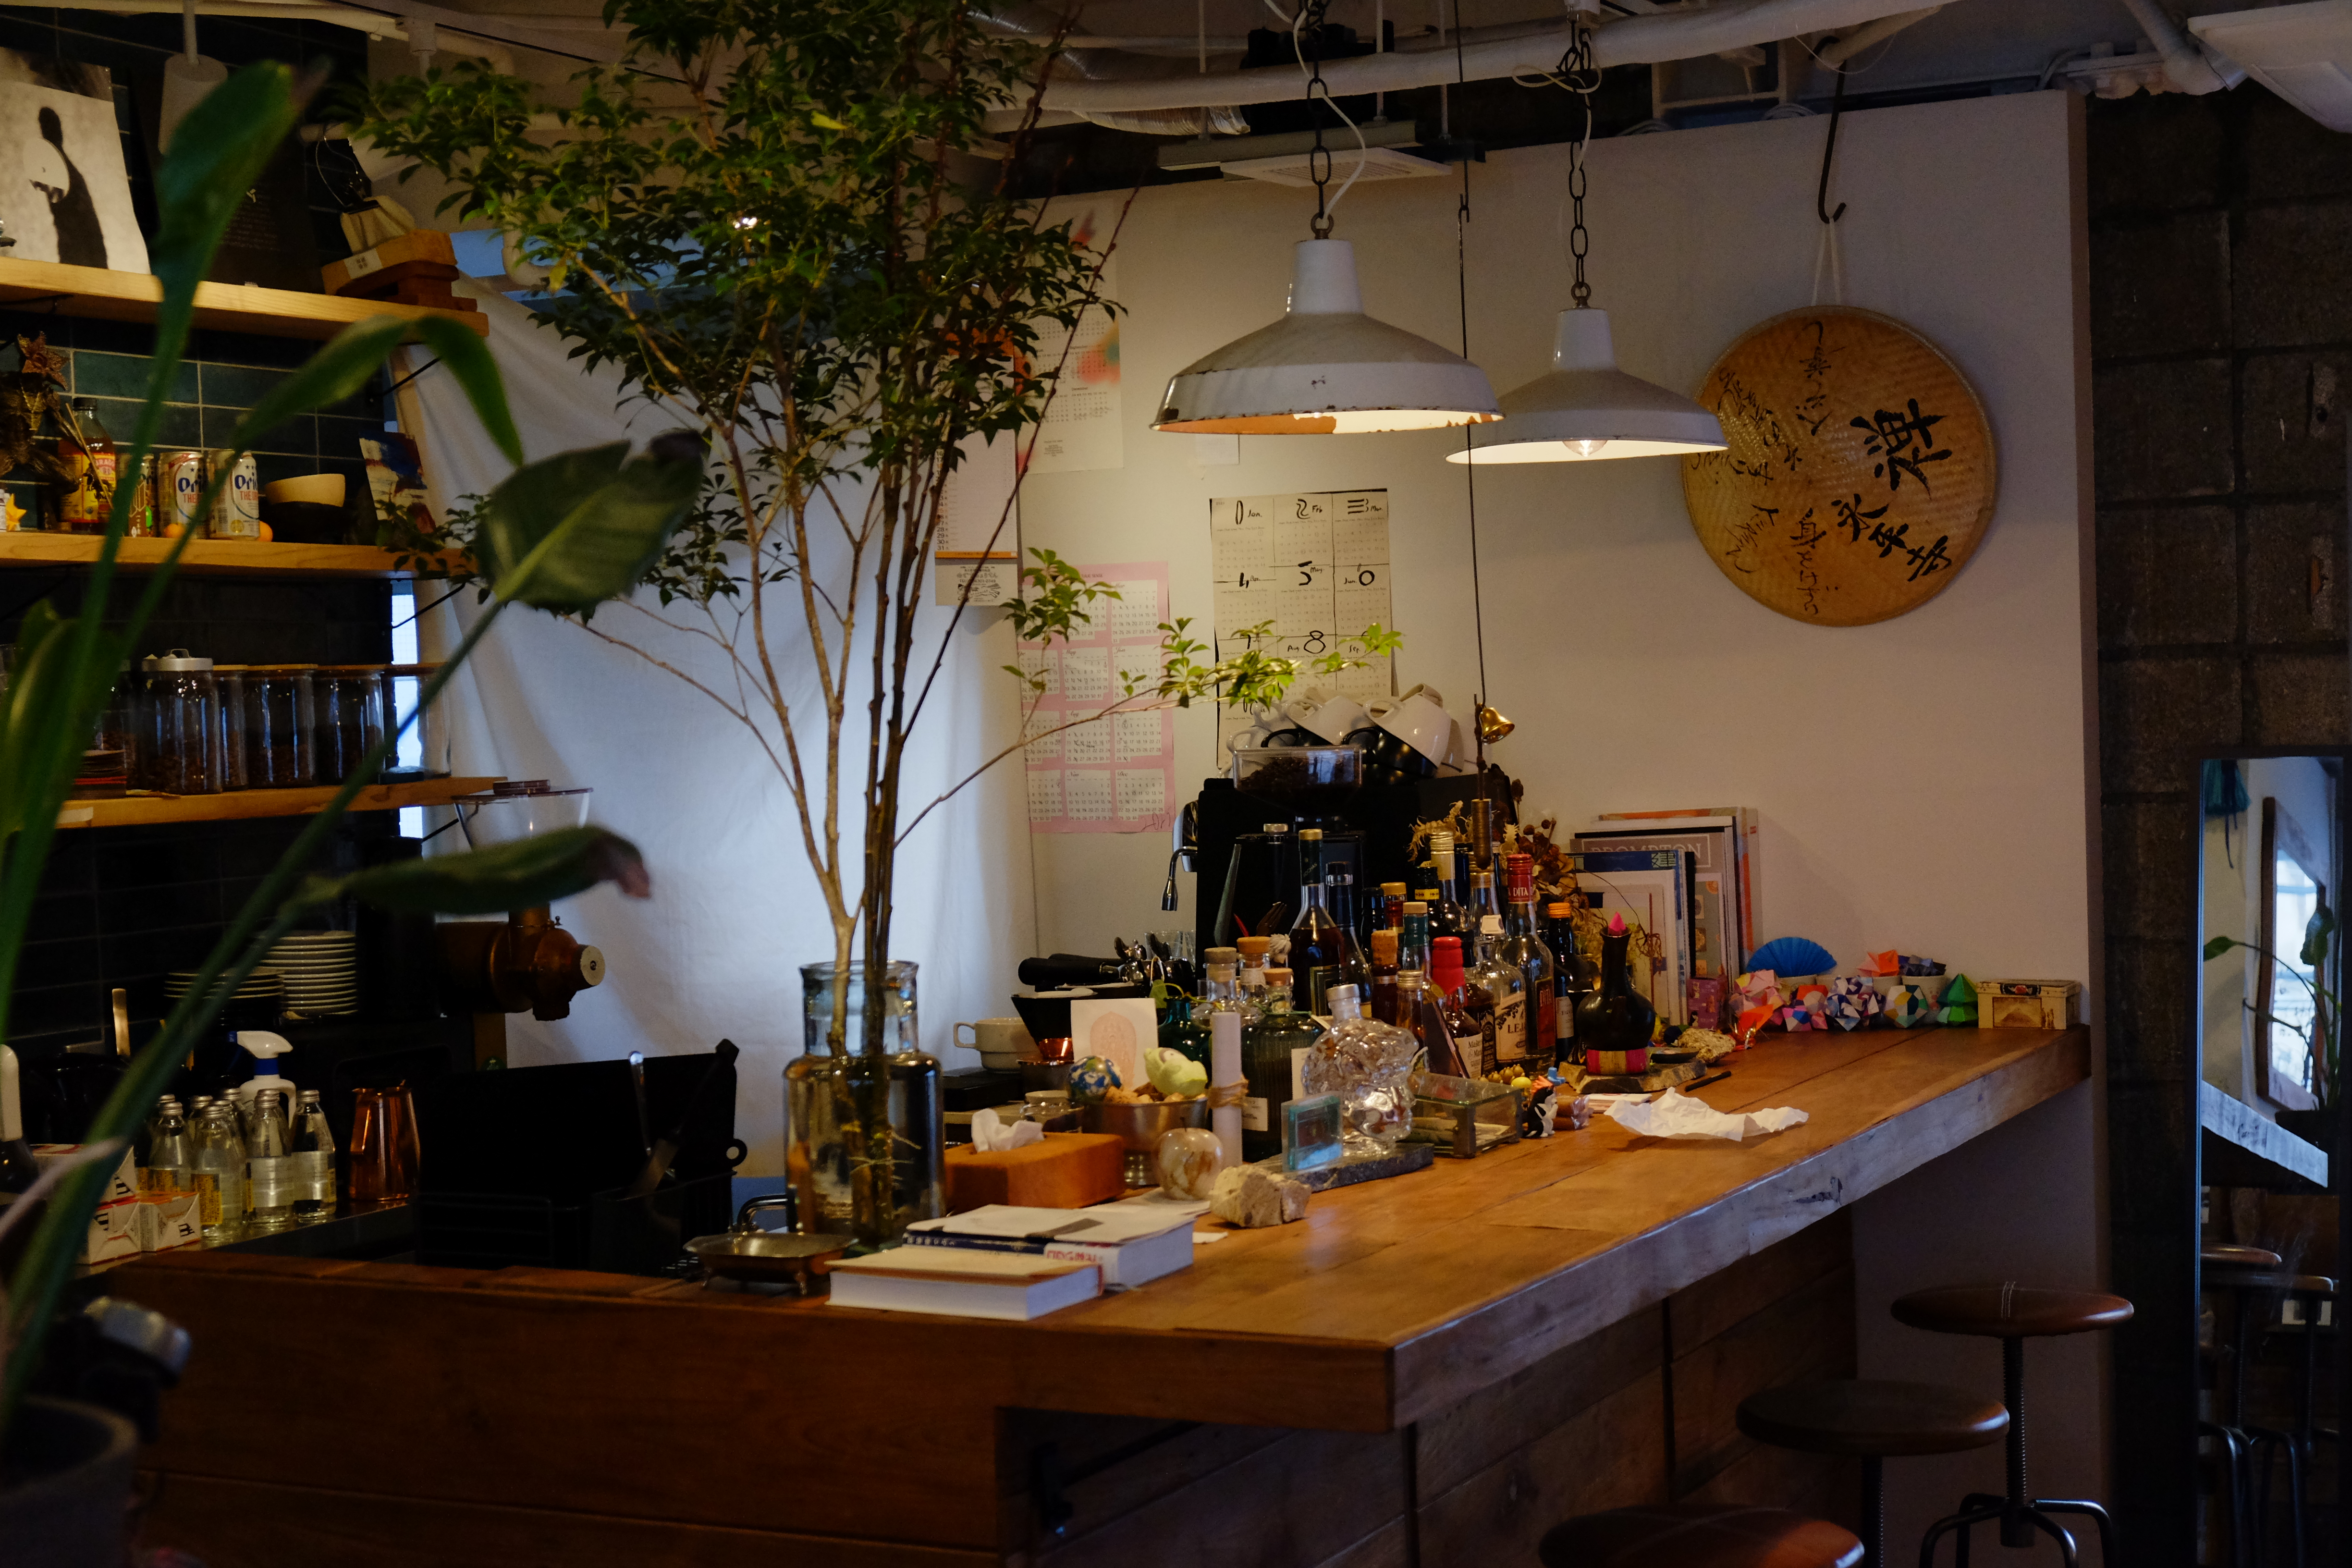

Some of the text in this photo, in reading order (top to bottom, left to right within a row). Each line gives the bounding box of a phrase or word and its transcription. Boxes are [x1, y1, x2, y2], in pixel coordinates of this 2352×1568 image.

[234, 475, 258, 490] Ori
[1303, 630, 1326, 654] 8
[1513, 887, 1528, 896] DITA
